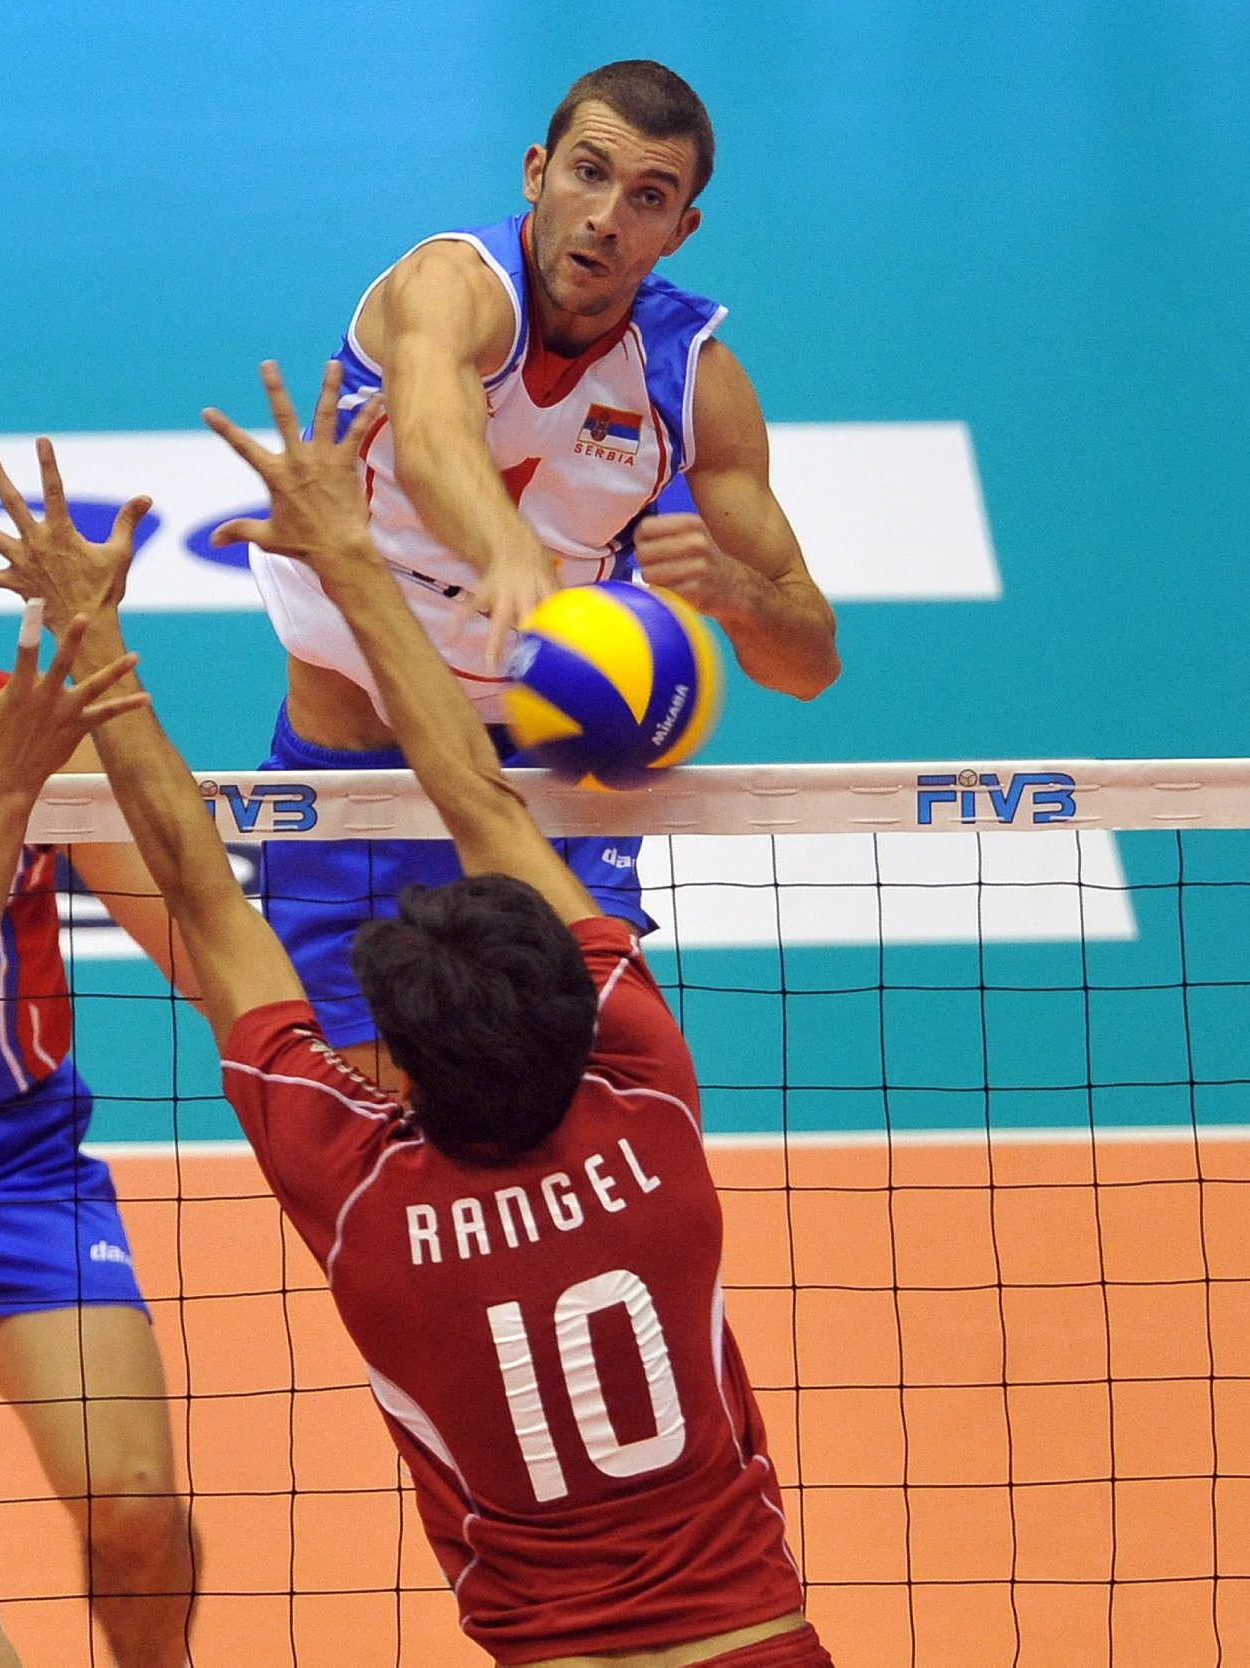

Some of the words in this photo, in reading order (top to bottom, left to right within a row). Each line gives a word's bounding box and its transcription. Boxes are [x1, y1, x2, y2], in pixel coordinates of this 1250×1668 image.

[573, 442, 635, 467] SERBIA
[406, 1138, 662, 1265] RANGEL
[486, 1269, 687, 1503] 10
